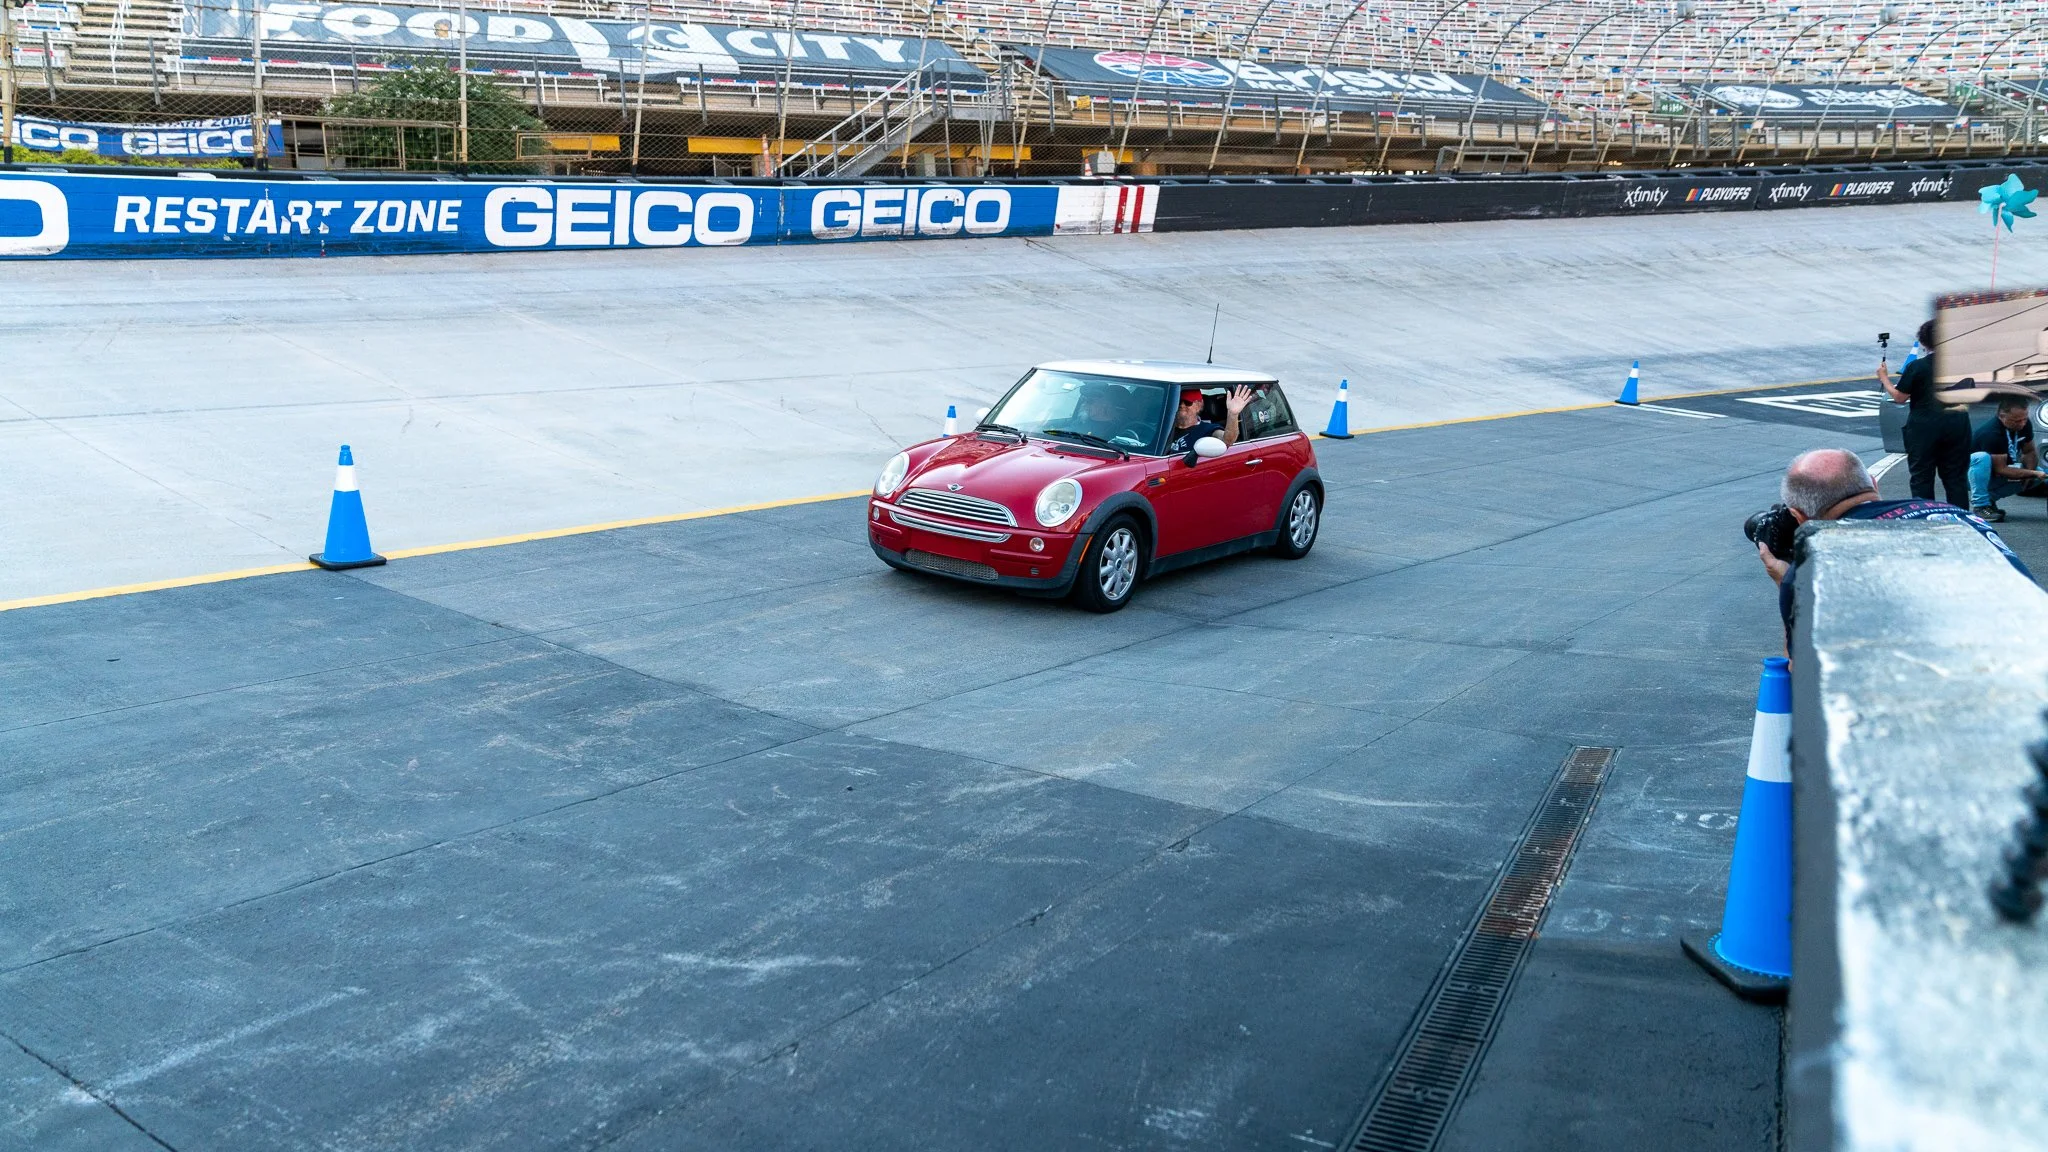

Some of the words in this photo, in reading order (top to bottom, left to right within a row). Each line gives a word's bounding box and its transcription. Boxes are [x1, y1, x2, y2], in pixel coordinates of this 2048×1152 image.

[255, 3, 553, 43] FOOD
[726, 29, 905, 63] CITY
[1213, 58, 1474, 95] Bristol
[1624, 186, 1669, 207] xfinity
[1700, 187, 1752, 201] PLAYOFFS
[1768, 182, 1812, 203] xfinity
[1843, 181, 1895, 196] PLAYOFFS
[1908, 176, 1953, 198] xfinity
[113, 196, 343, 235] RESTART
[349, 200, 463, 234] ZONE
[484, 187, 755, 247] GEICO
[811, 189, 1011, 239] GEICO
